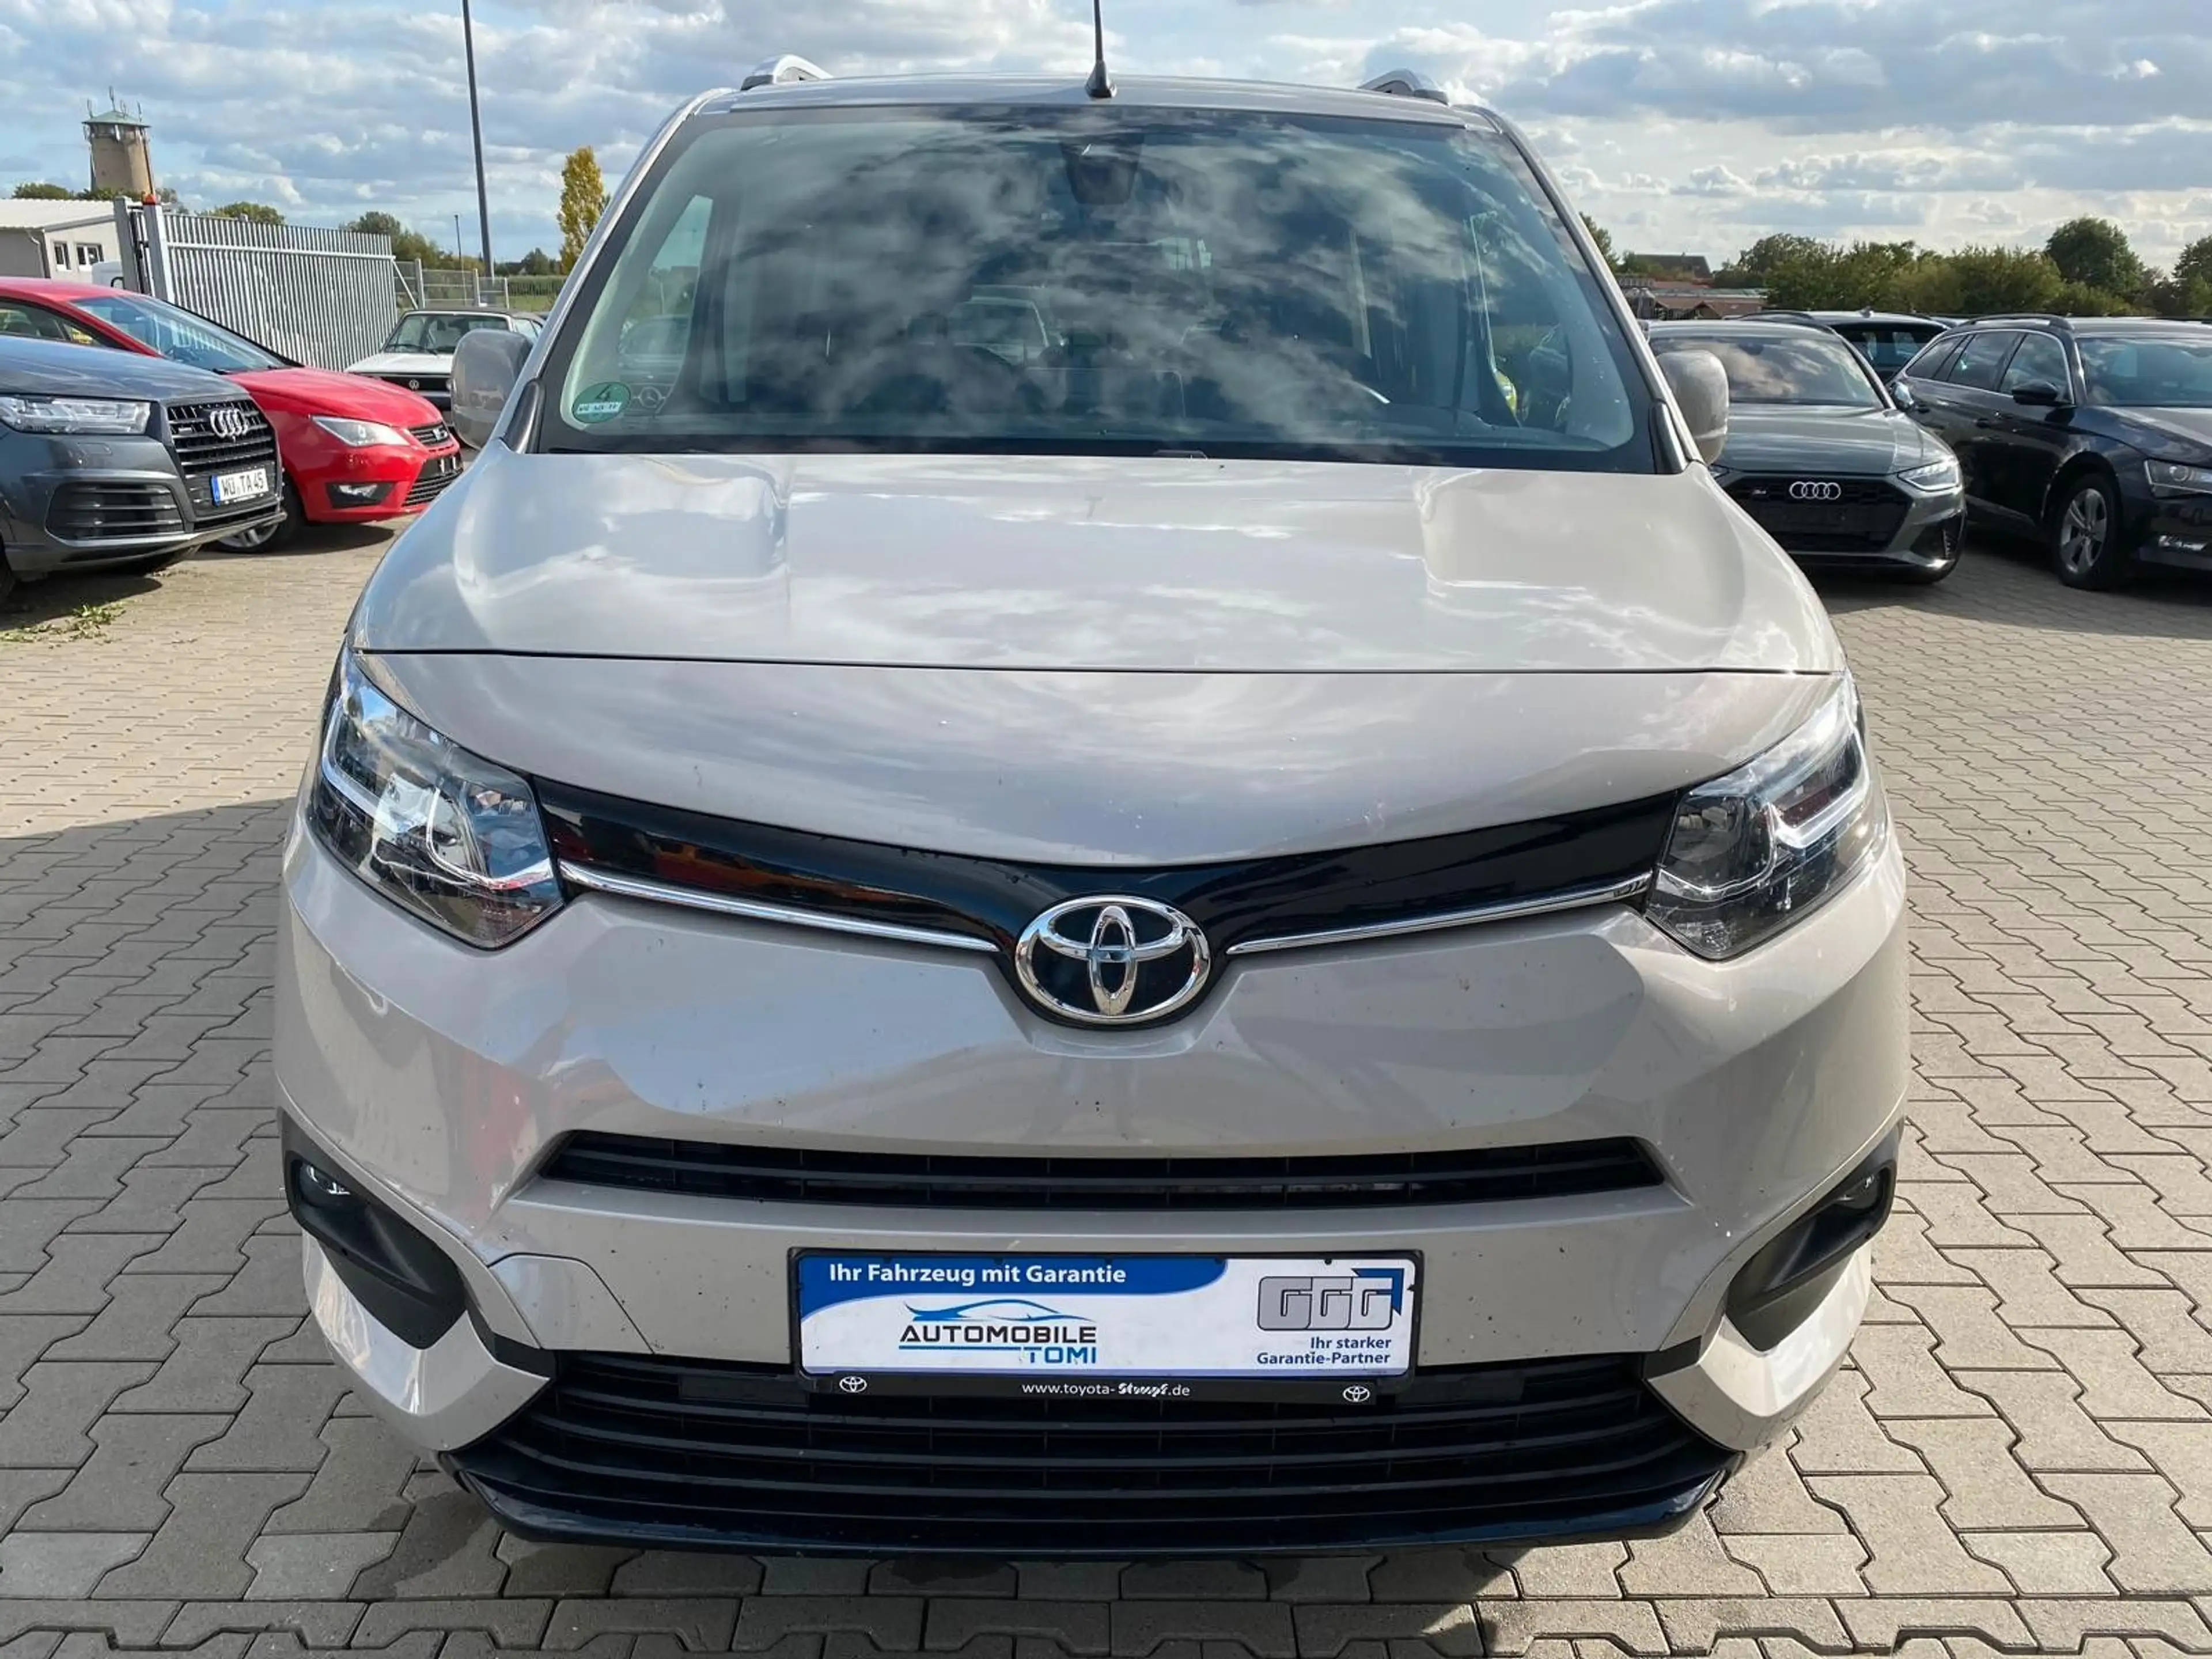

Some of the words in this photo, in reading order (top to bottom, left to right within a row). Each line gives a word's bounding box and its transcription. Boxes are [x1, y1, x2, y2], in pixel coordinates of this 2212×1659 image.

[830, 1264, 862, 1281] Ihr
[868, 1264, 975, 1286] Fahrzeug
[982, 1264, 1020, 1283] mit
[1026, 1265, 1127, 1283] Garantie
[900, 1325, 1097, 1343] AUTOMOBILE
[1310, 1336, 1332, 1349] Ihr
[1336, 1336, 1392, 1349] starker
[1023, 1346, 1097, 1364] TOMI
[1257, 1351, 1391, 1365] Garantie-Partner
